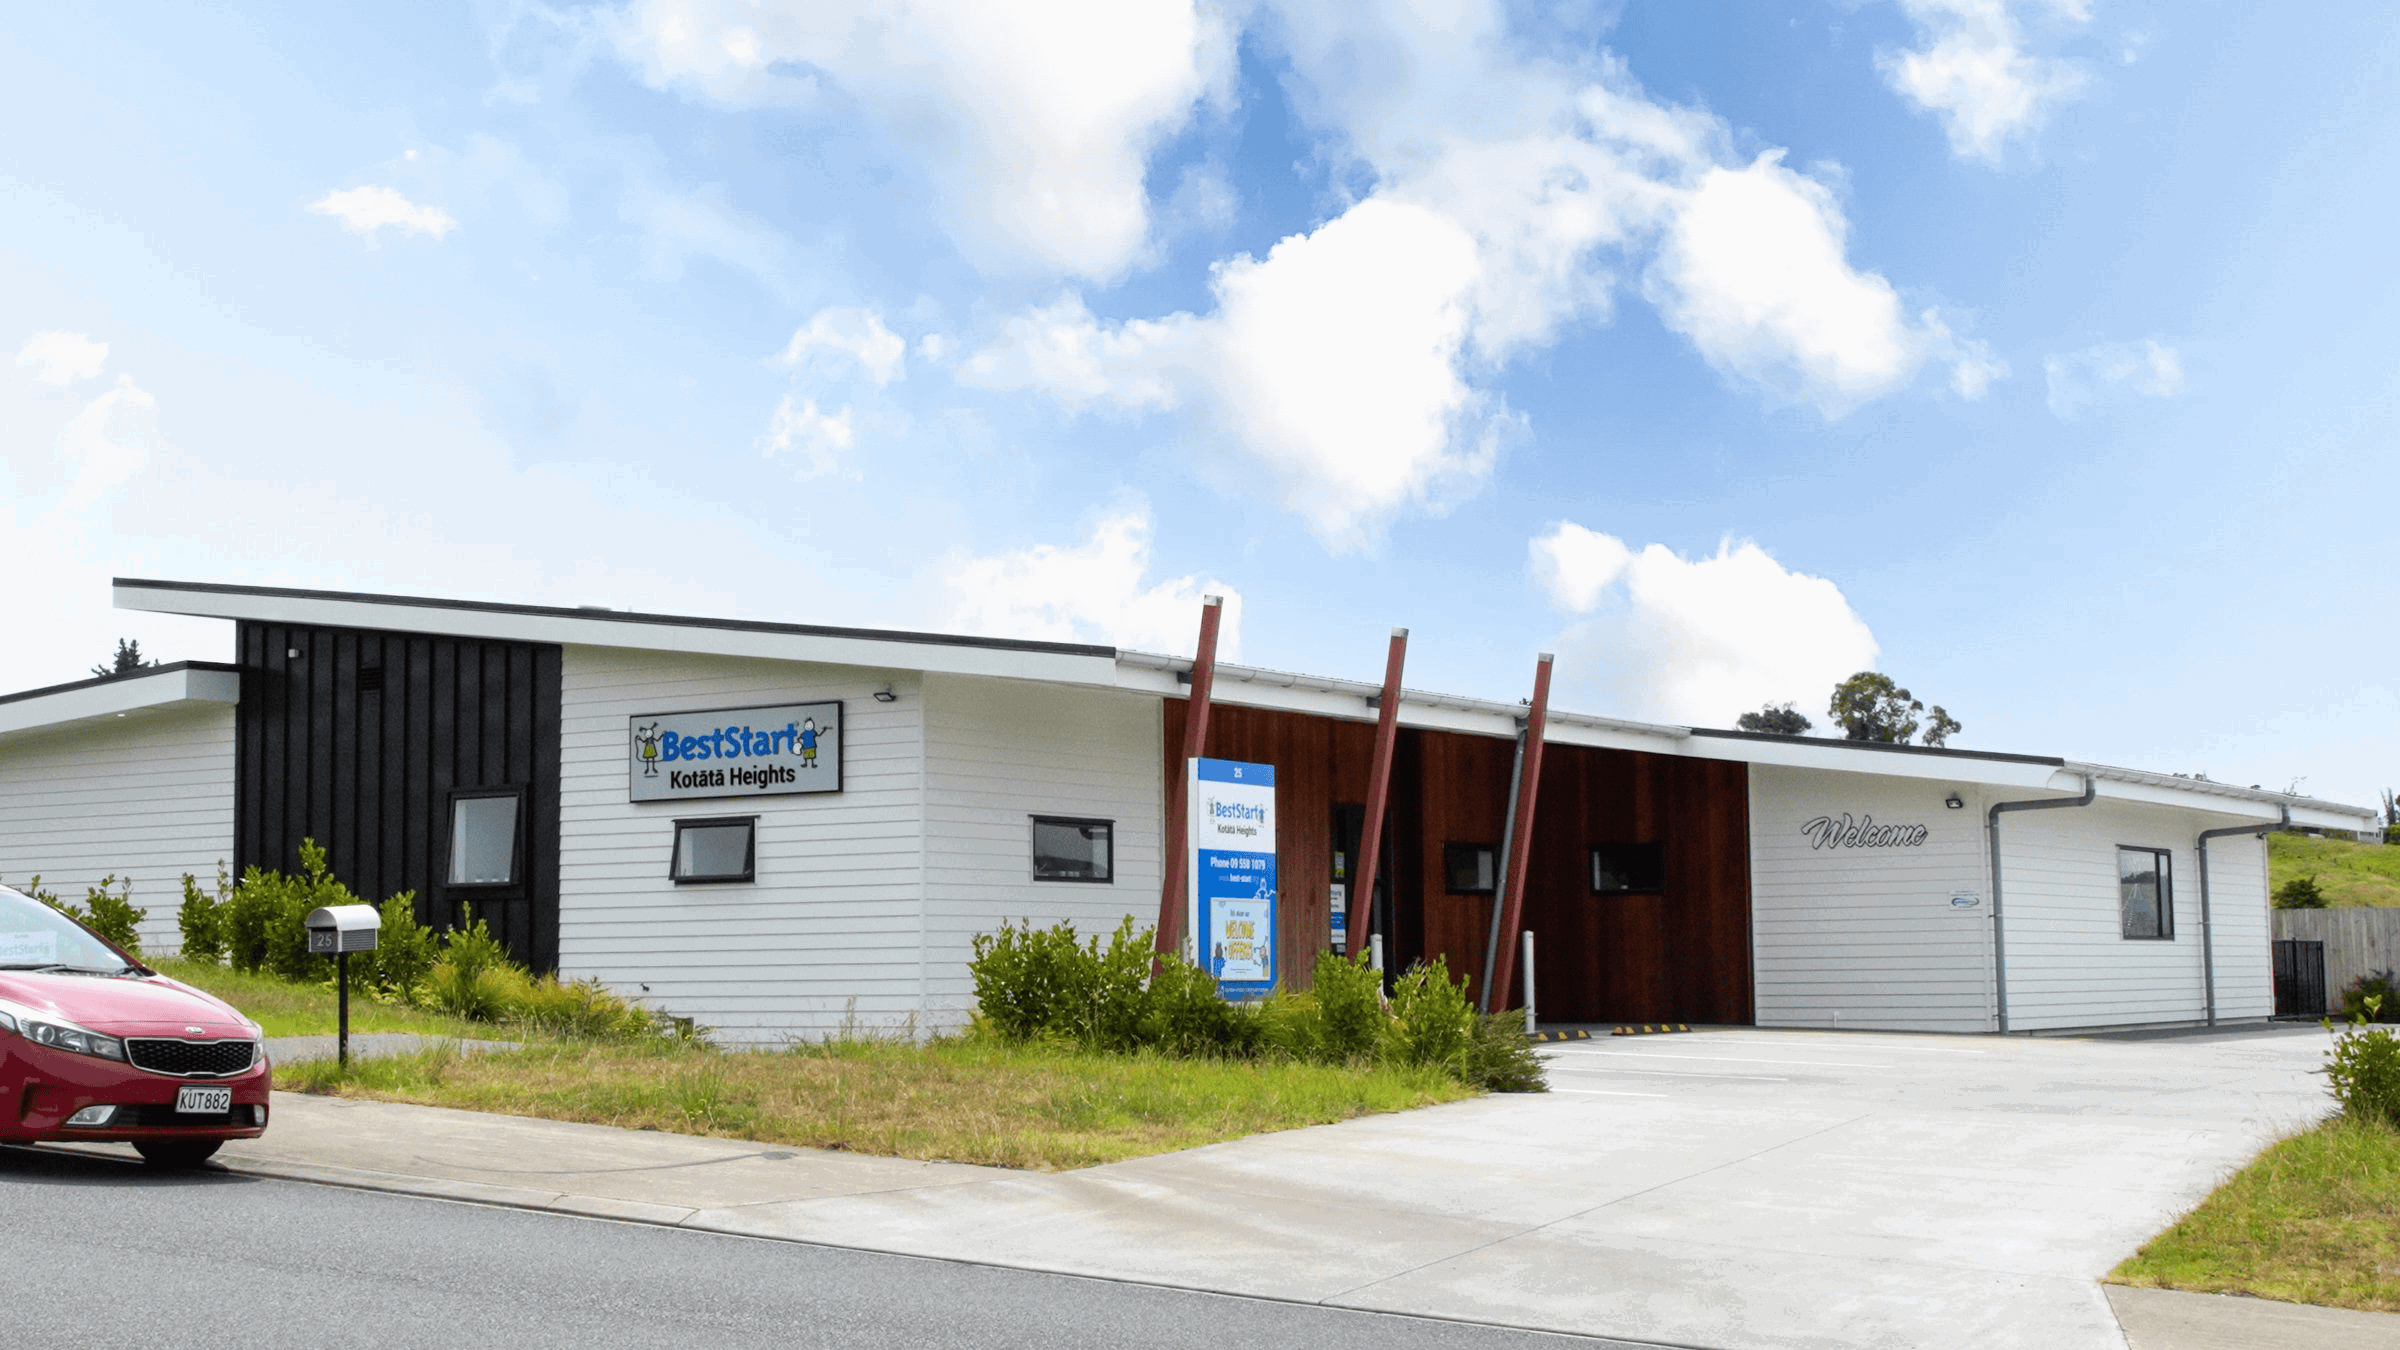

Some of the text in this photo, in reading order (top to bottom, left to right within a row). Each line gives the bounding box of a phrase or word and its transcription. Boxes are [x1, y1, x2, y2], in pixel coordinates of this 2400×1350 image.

[662, 724, 798, 761] BestStart
[670, 764, 796, 789] Kotātā Heights
[1233, 767, 1243, 779] 25
[1216, 801, 1258, 820] BestStart
[1236, 825, 1257, 838] Heights
[1800, 813, 1929, 850] Welcome
[1210, 856, 1230, 869] Phone
[1230, 857, 1239, 869] 09
[316, 933, 333, 948] 25
[179, 1092, 229, 1110] KUT882
